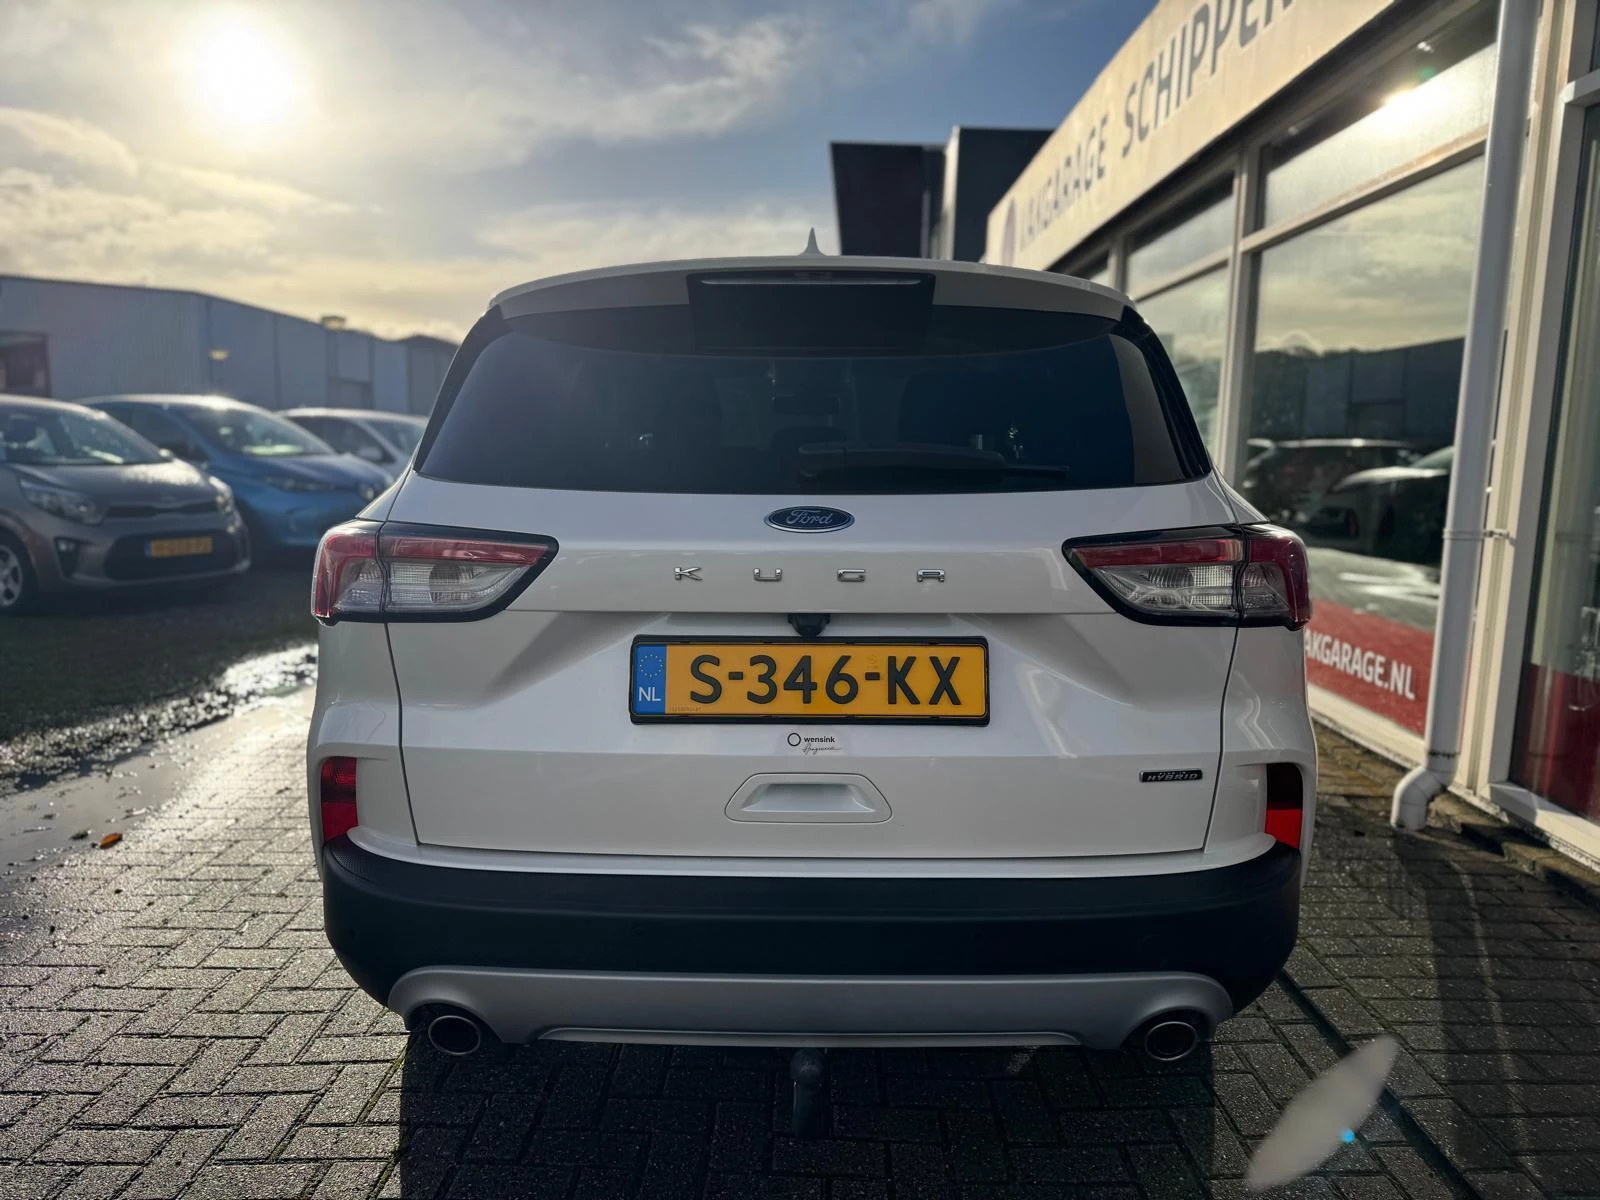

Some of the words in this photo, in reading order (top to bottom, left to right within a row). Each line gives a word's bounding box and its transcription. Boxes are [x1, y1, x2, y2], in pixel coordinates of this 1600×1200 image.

[1121, 0, 1292, 158] SCHIPPE
[786, 510, 833, 524] Ford
[674, 566, 945, 583] KUGA
[690, 654, 961, 706] S-346-KX
[638, 686, 661, 702] NL
[803, 735, 836, 743] wensink
[1147, 773, 1198, 781] HYBRID
